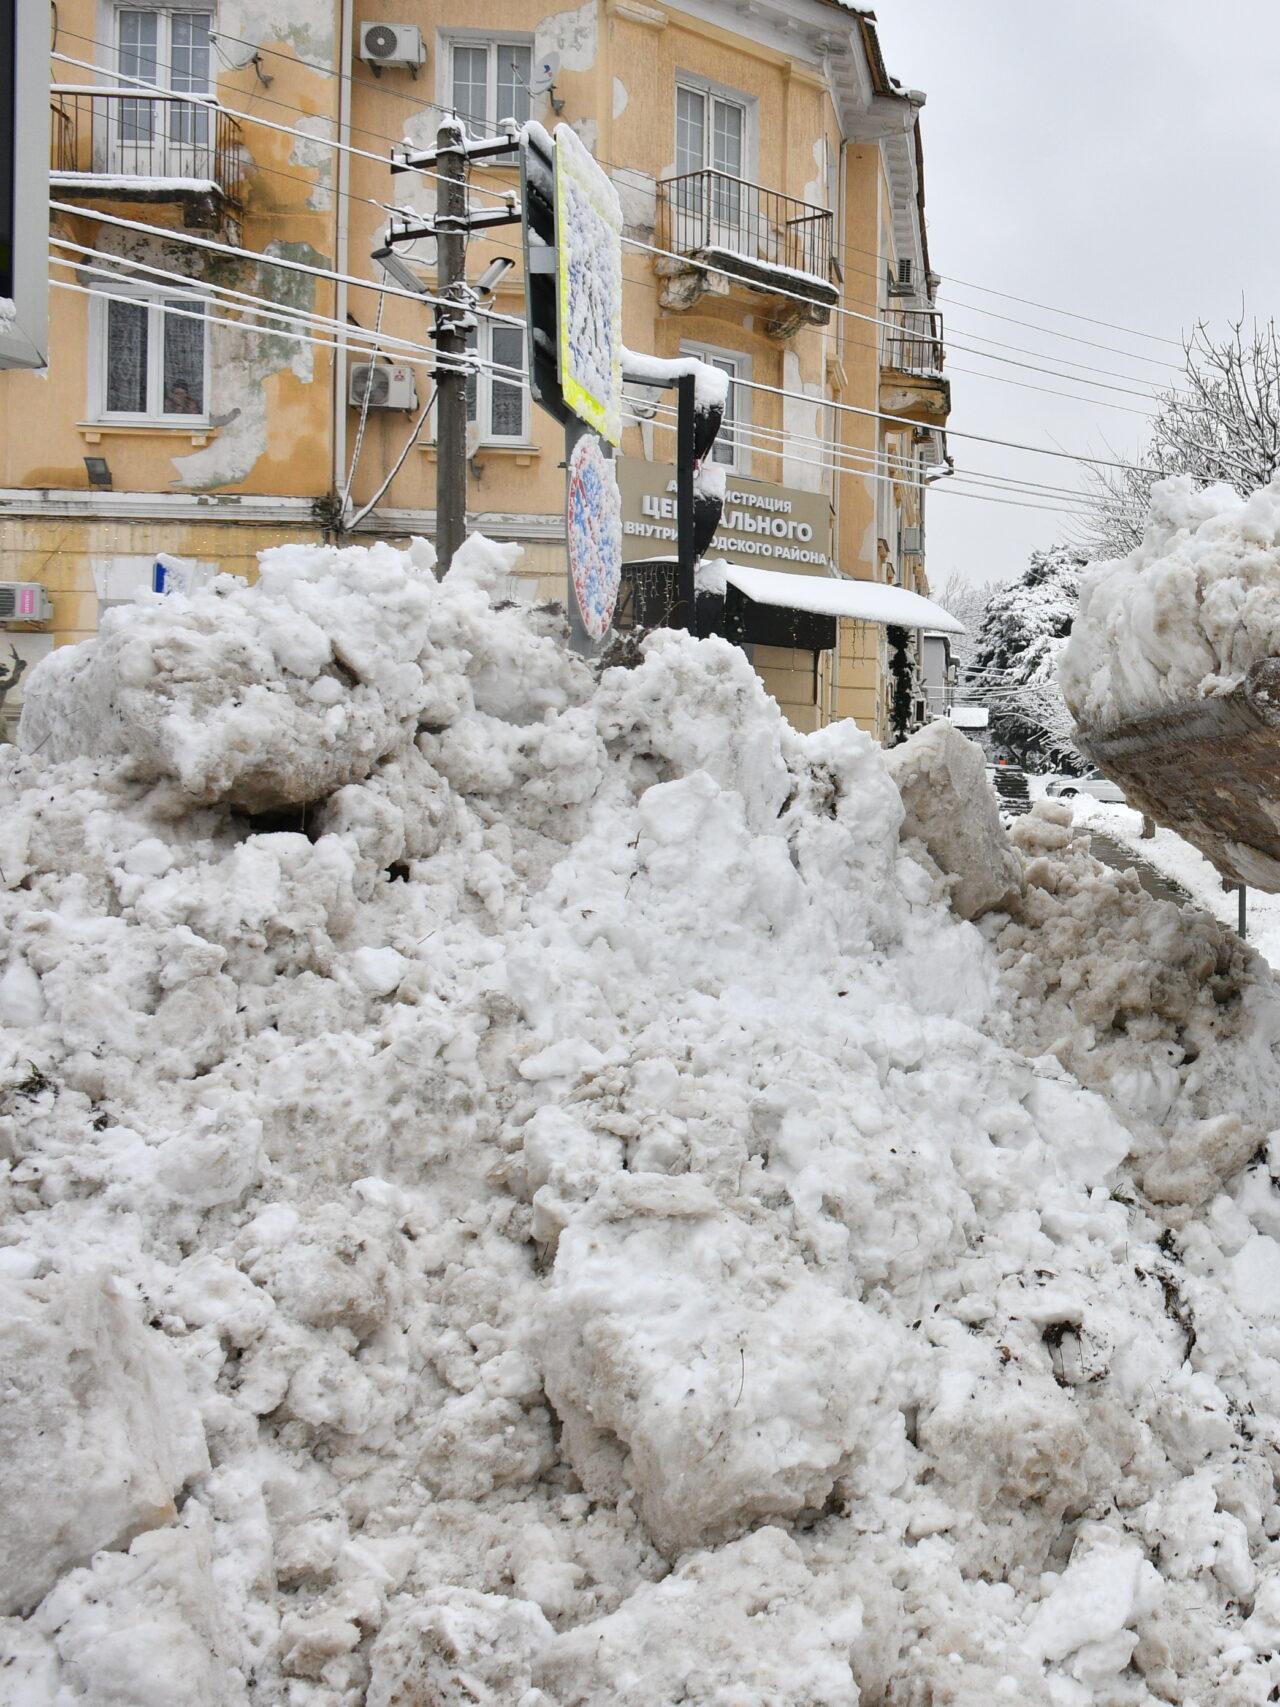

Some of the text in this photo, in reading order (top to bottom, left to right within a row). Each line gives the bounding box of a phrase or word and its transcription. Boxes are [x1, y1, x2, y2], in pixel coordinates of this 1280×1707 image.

[642, 495, 813, 542] ЦЕАЛЬНОГО
[665, 480, 792, 513] АИСТРАЦИЯ
[624, 521, 827, 565] ВНУТРИОДСКОГО РАЙОНА
